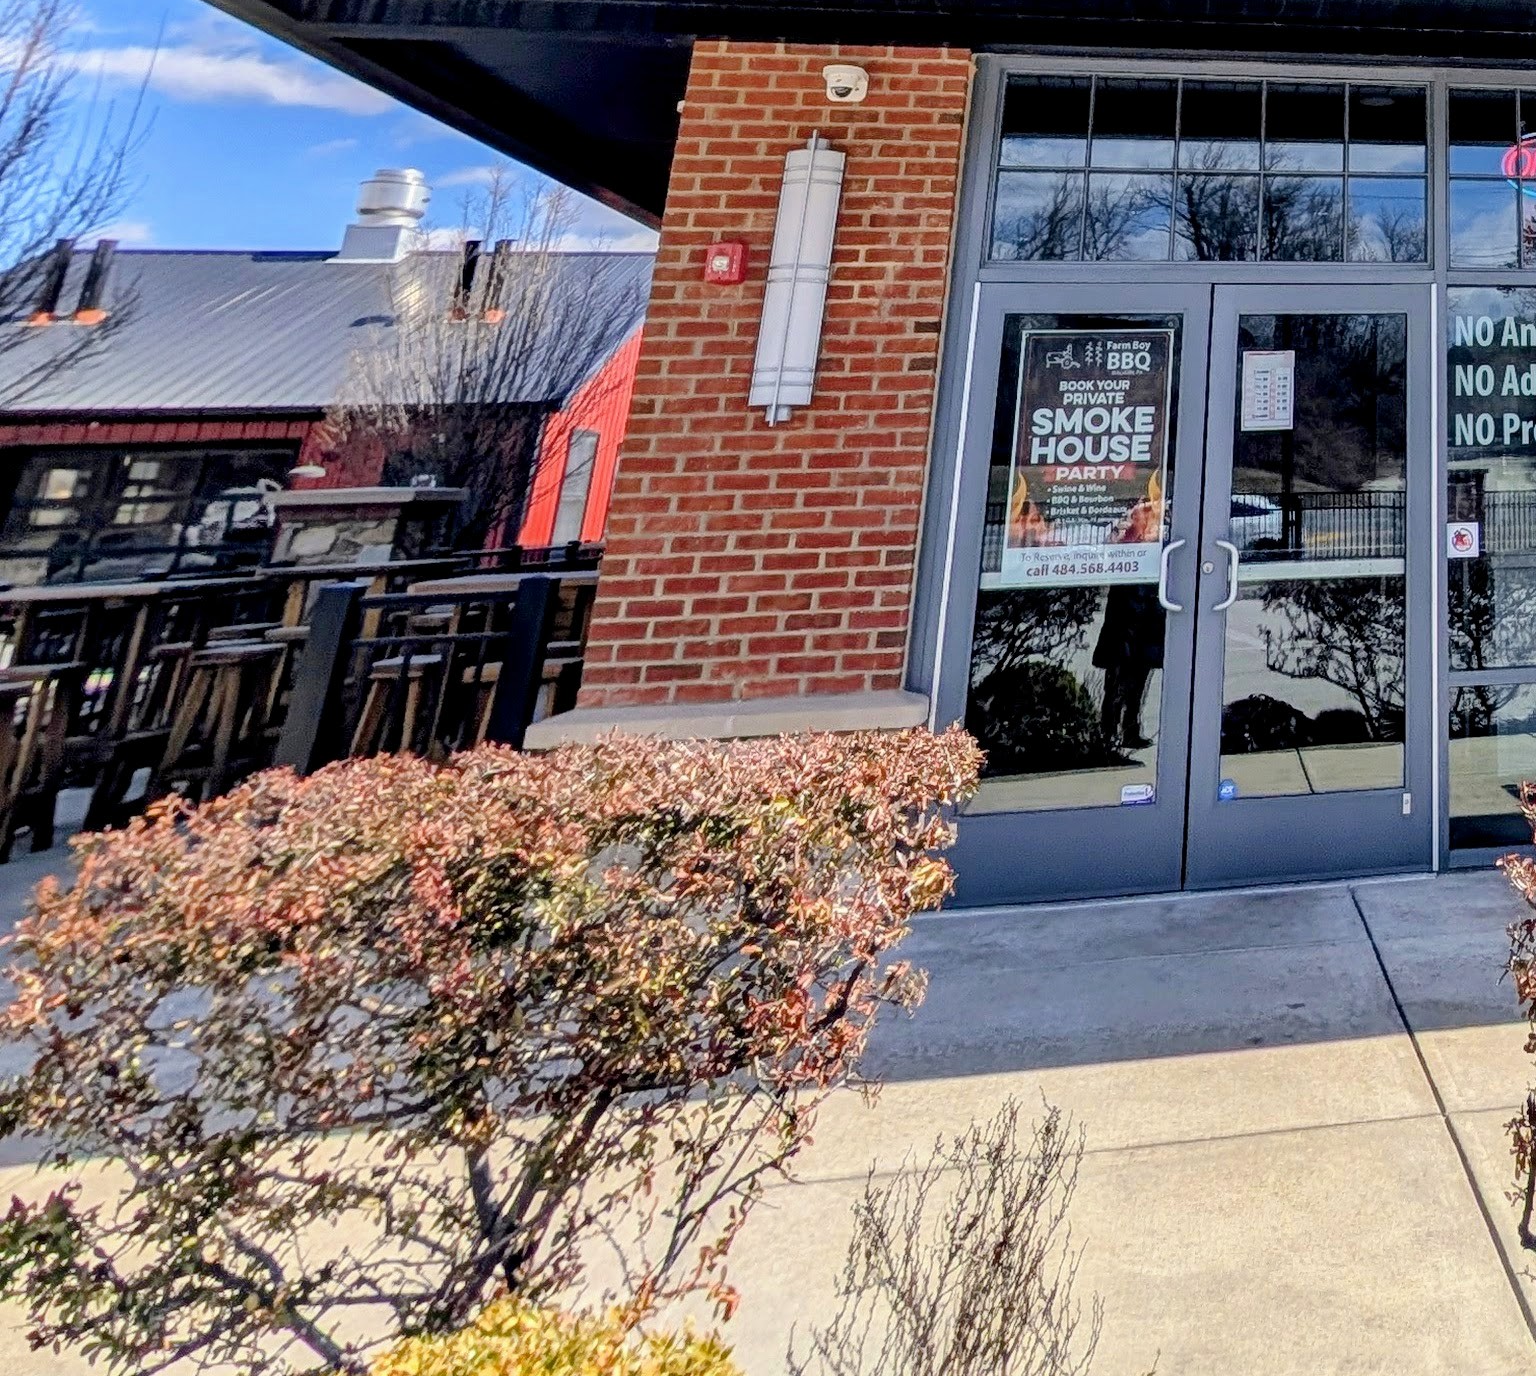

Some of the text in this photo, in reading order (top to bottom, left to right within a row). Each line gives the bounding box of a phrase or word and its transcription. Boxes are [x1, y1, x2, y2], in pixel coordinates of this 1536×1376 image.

[1455, 315, 1494, 347] NO
[1106, 341, 1151, 352] Farm Boy
[1106, 352, 1151, 371] BBQ
[1059, 380, 1130, 392] BOOK YOUR
[1455, 364, 1494, 396] NO
[1063, 392, 1125, 405] PRIVATE
[1031, 406, 1156, 435] SMOKE
[1455, 413, 1495, 445] NO
[1030, 434, 1152, 464] HOUSE
[1055, 465, 1125, 481] PARTY
[1026, 561, 1139, 576] call 484.568.4403
